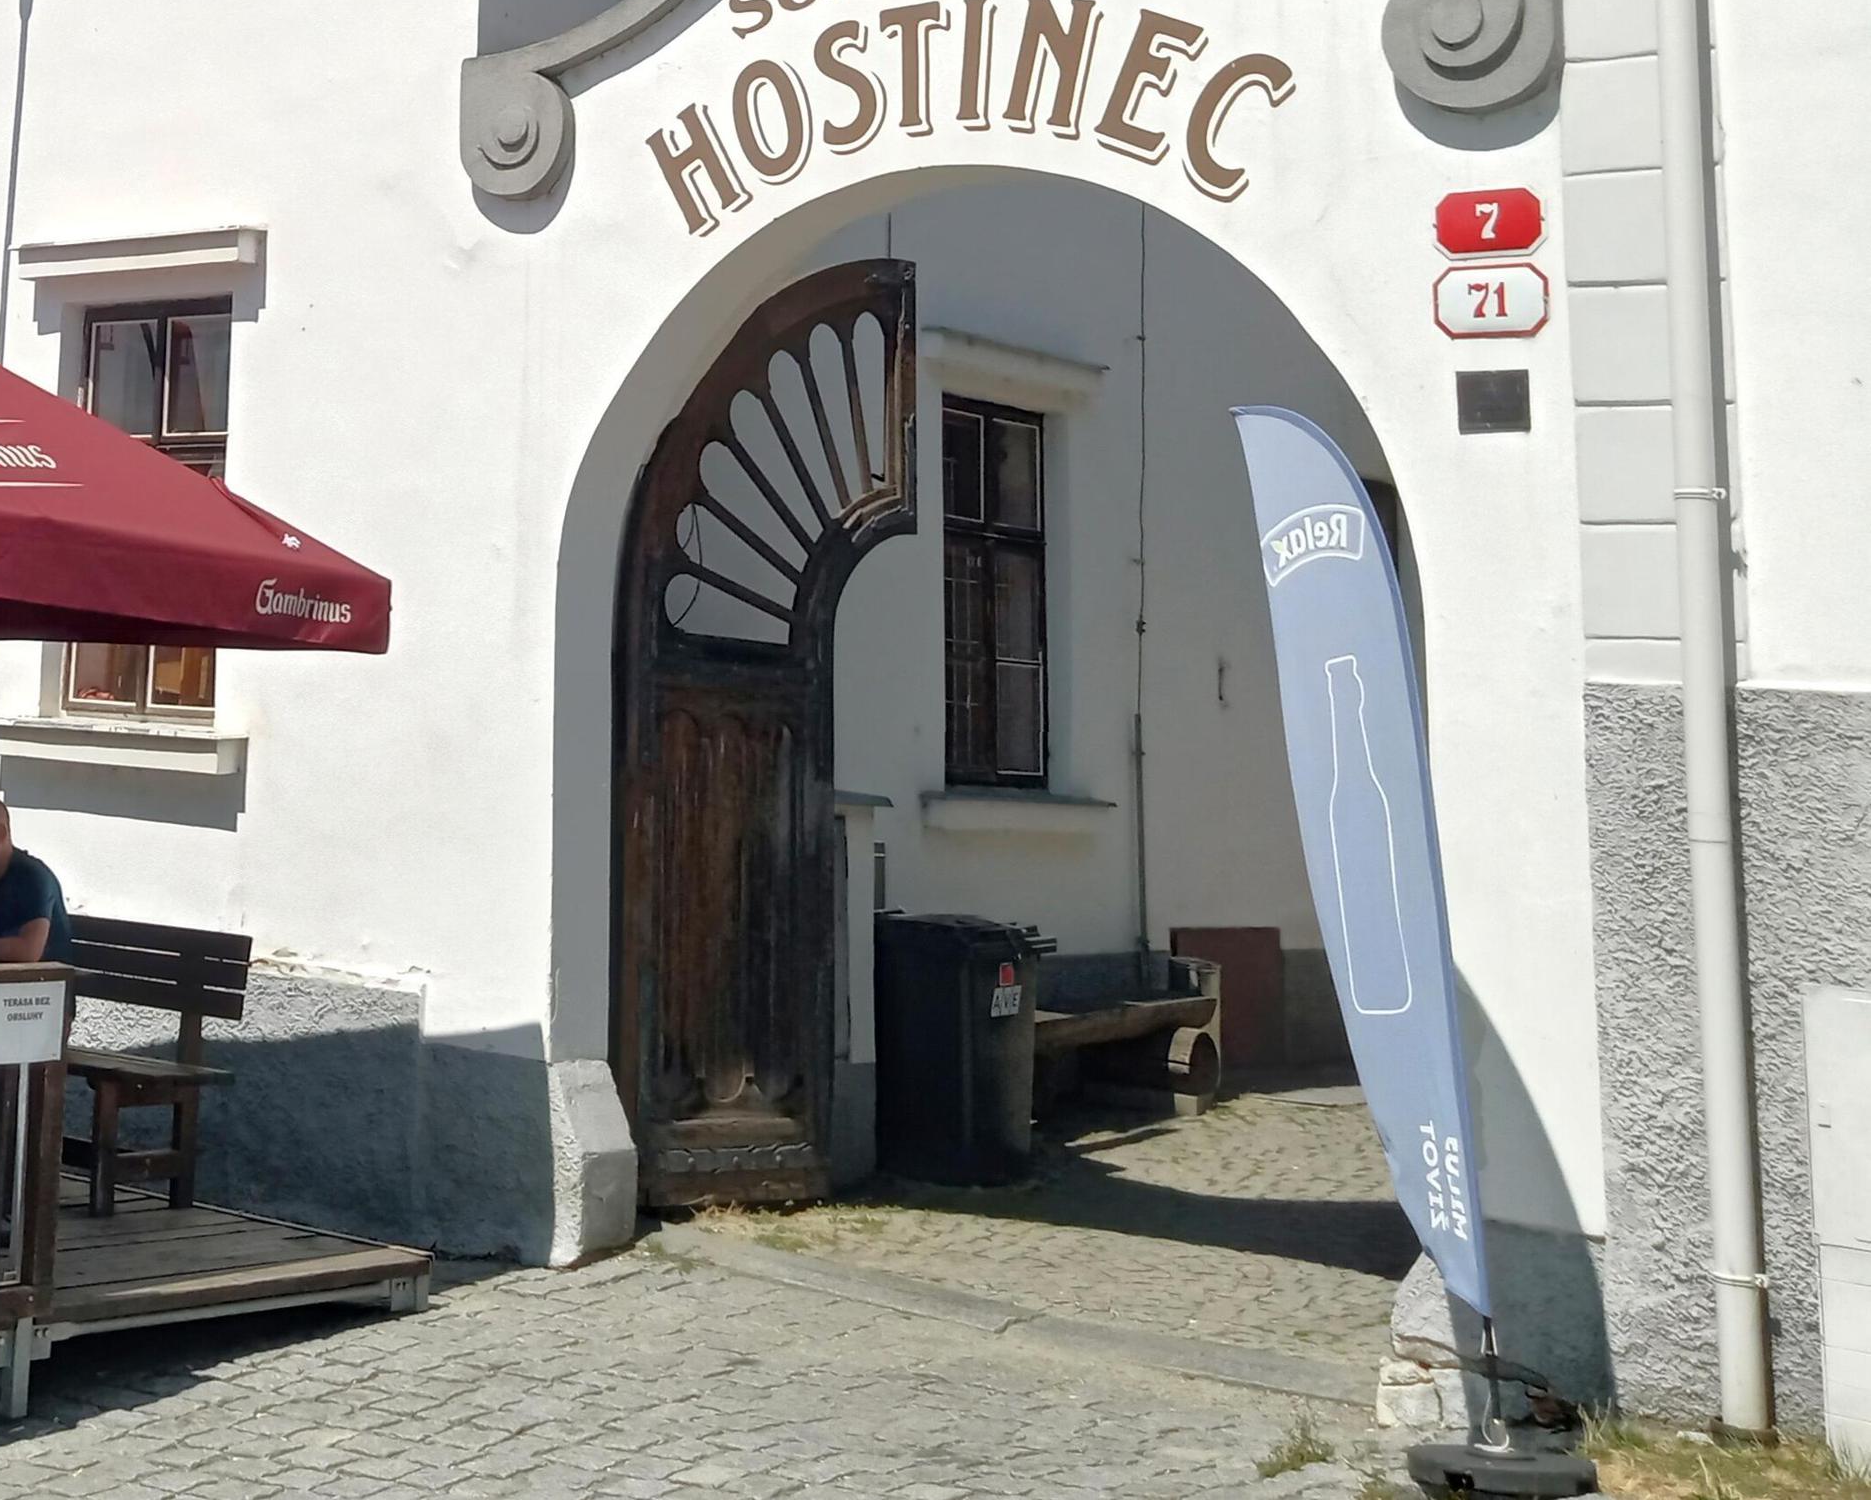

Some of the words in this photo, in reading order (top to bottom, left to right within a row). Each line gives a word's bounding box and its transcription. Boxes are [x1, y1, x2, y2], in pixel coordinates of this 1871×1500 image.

[1474, 202, 1500, 240] 7
[1467, 281, 1509, 319] 71
[255, 577, 352, 624] Gambrinus
[2, 997, 34, 1007] TERASA
